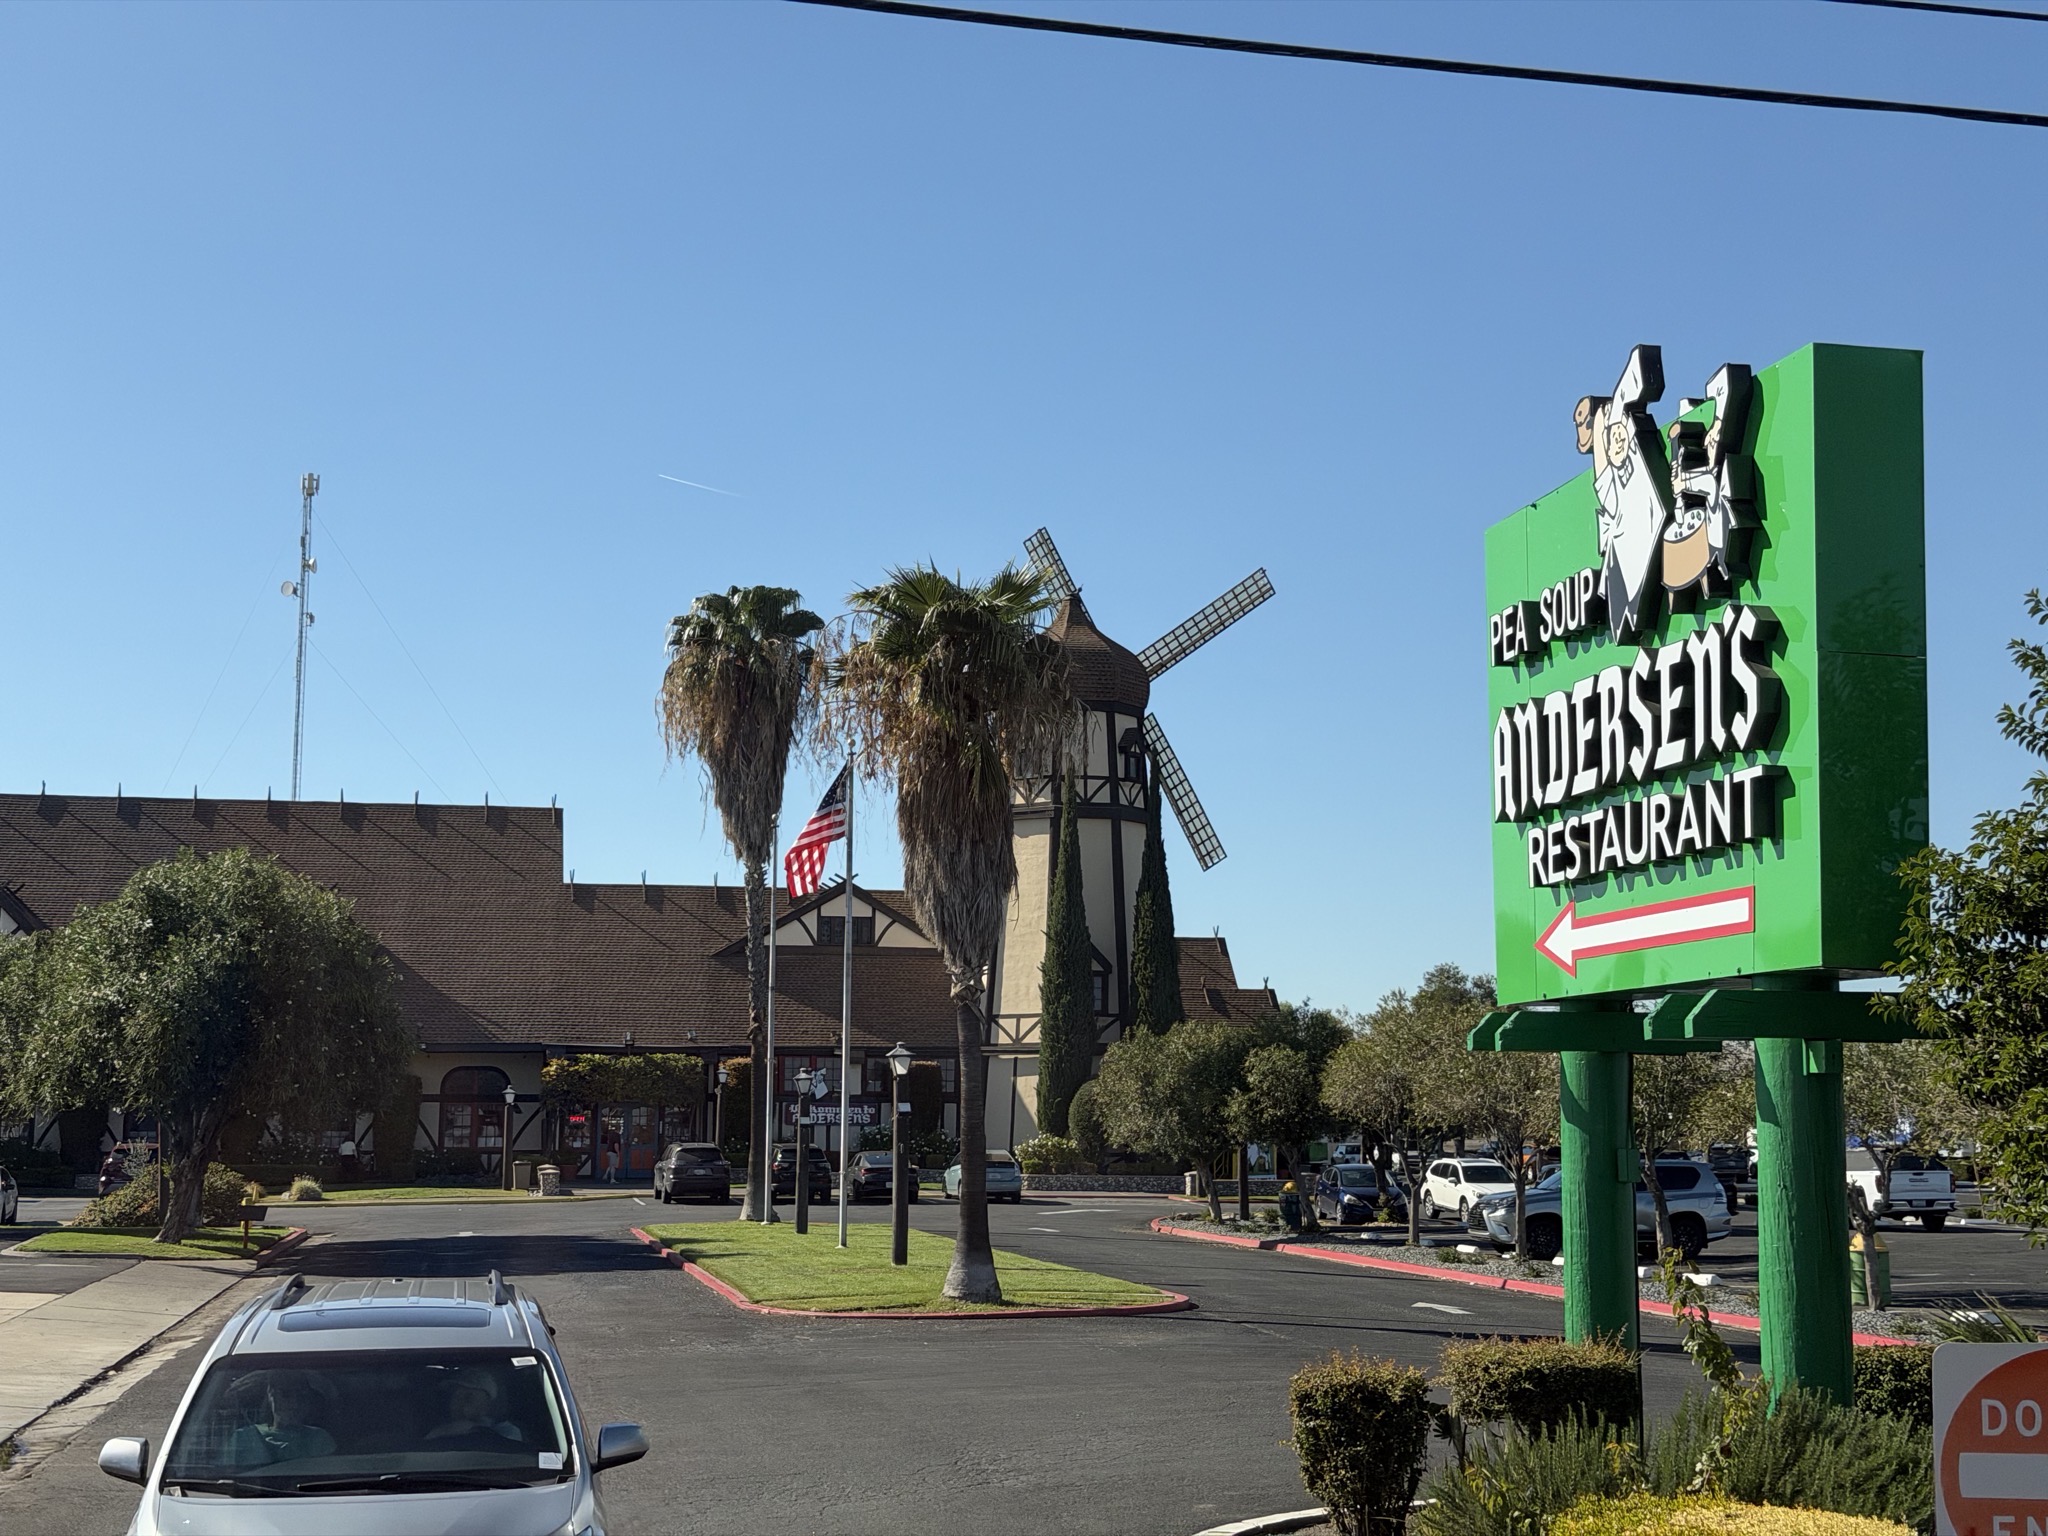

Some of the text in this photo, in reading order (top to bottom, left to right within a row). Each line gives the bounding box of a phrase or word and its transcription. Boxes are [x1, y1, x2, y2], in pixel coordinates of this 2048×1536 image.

[1490, 568, 1593, 667] PEA SOUP
[1493, 602, 1758, 823] ANDERSEN'S
[1528, 764, 1764, 889] RESTAURANT
[788, 1104, 862, 1113] Vkomen
[792, 1113, 871, 1123] ADERSN'S
[1981, 1398, 2043, 1437] DO
